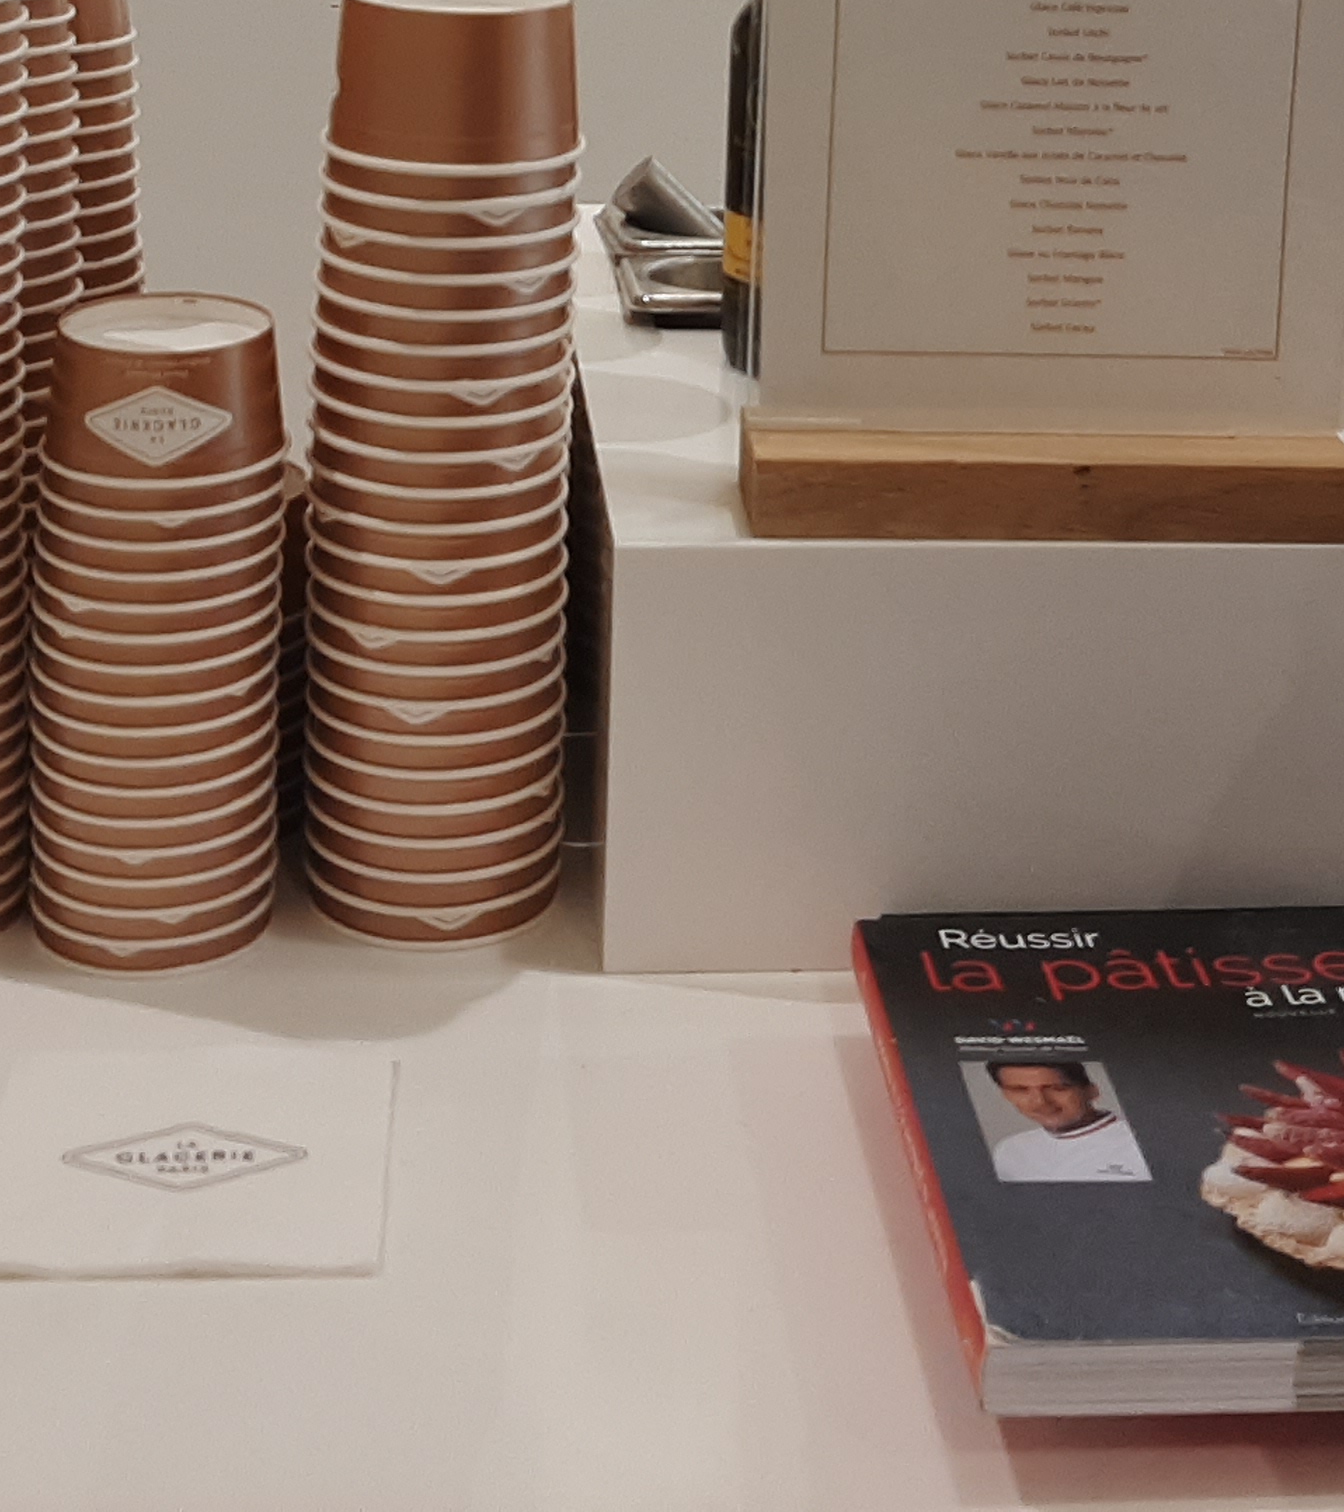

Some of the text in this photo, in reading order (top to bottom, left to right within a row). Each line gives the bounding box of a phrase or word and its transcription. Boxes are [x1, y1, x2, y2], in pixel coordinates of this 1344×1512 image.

[937, 928, 1101, 950] Réussir
[920, 951, 1004, 992] la
[1244, 986, 1273, 1008] à
[1281, 985, 1327, 1006] la
[115, 1150, 254, 1164] GLACERIE
